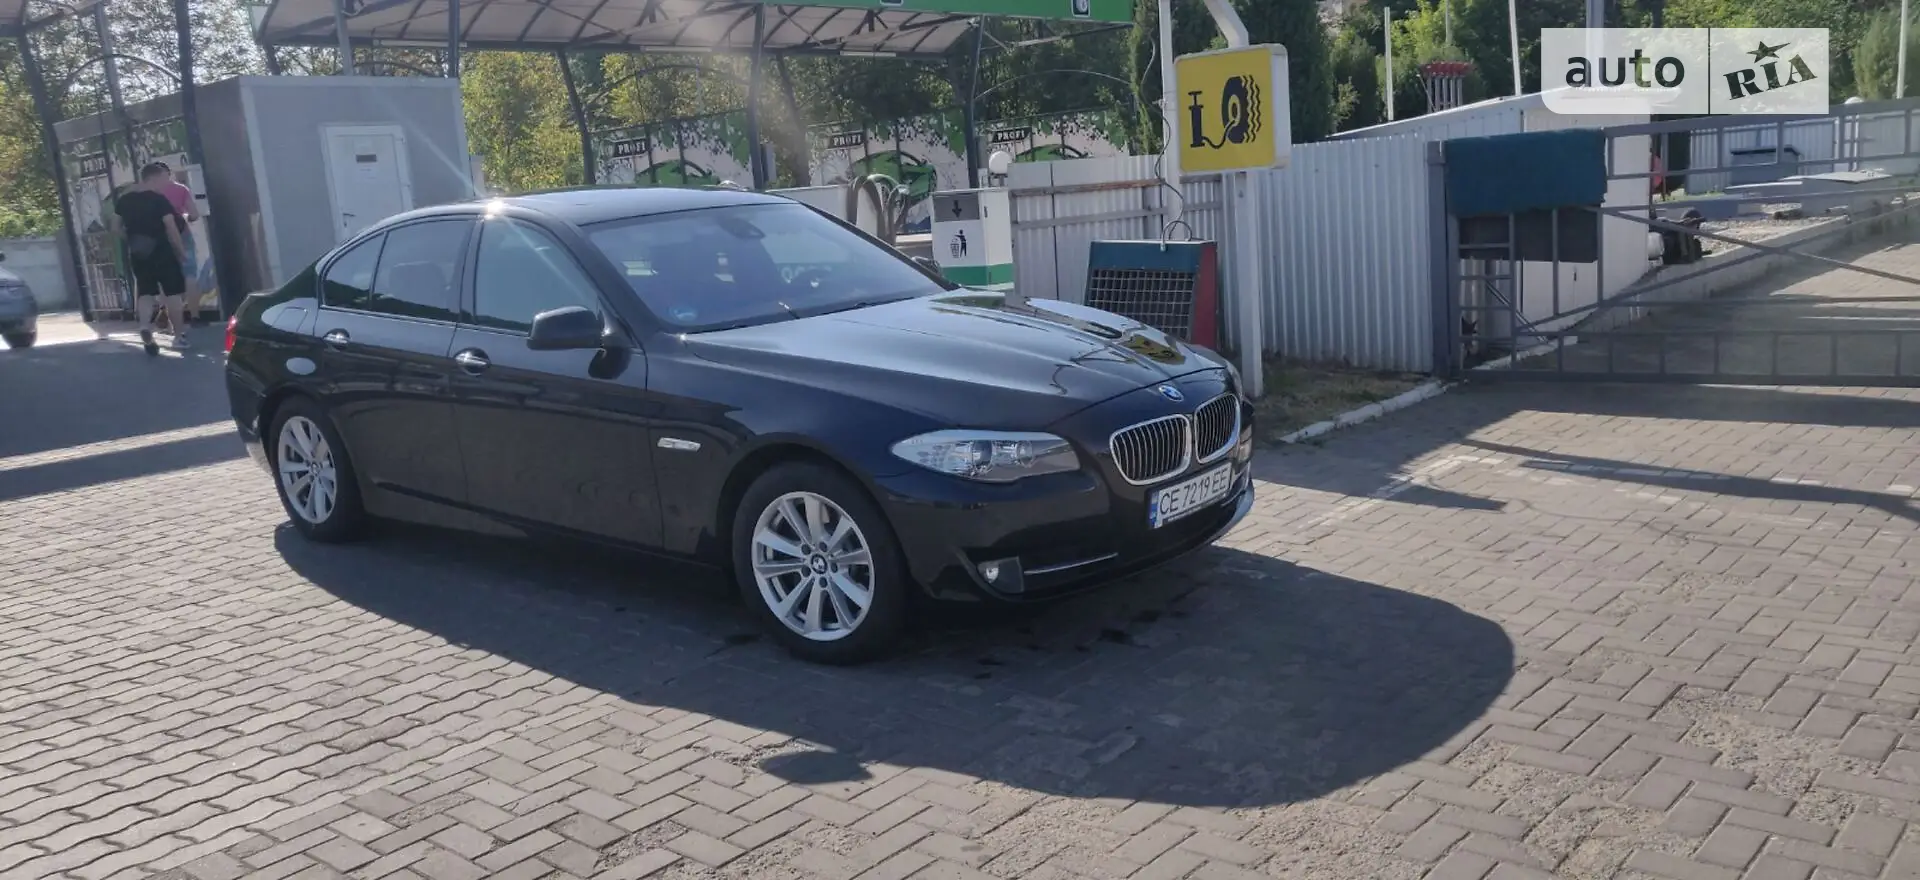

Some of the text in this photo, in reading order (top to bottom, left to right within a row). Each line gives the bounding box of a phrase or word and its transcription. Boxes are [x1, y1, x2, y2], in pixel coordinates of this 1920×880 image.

[833, 133, 862, 147] PROFI
[996, 129, 1026, 141] PROFI
[617, 140, 647, 155] PROFI
[1160, 488, 1180, 515] CE
[1182, 476, 1211, 508] 7219
[1211, 467, 1229, 494] EE
